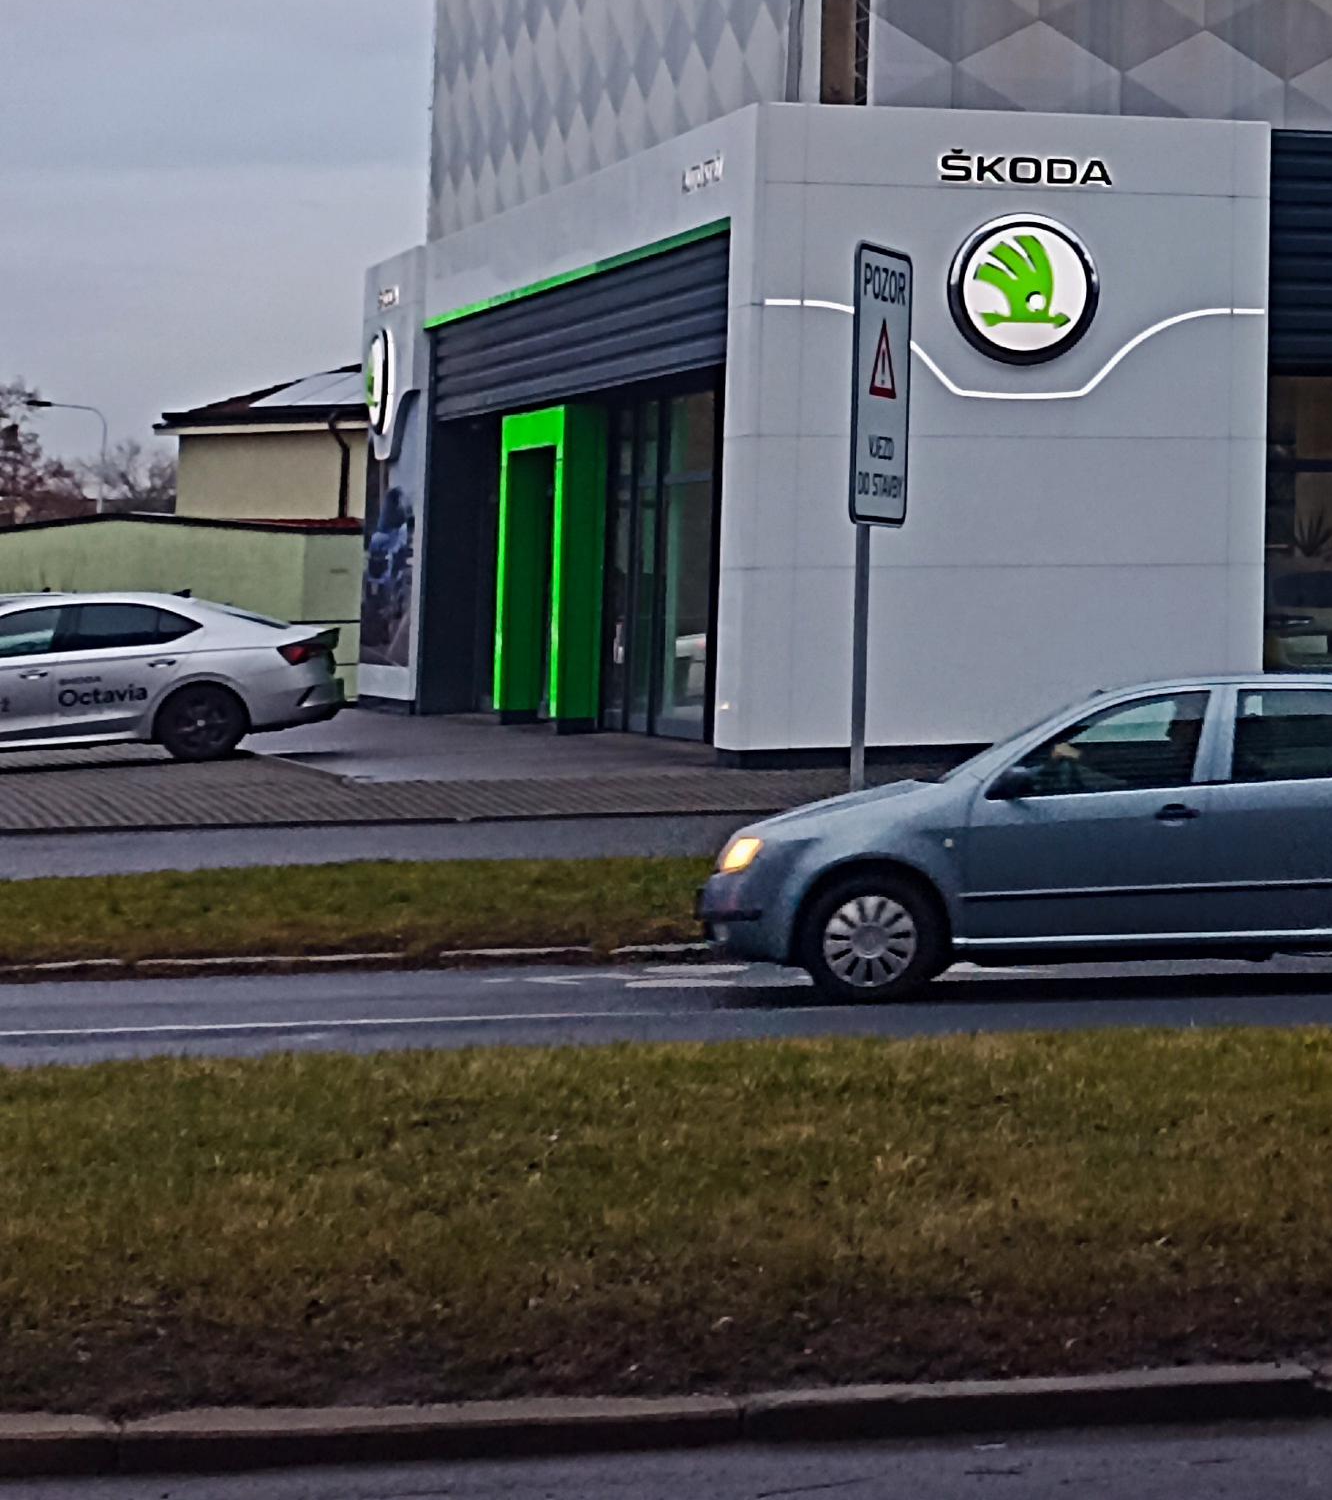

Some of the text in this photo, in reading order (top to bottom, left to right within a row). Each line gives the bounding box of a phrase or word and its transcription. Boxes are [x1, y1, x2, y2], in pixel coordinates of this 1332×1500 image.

[940, 148, 1112, 185] ŠKODA
[864, 262, 906, 306] POZOR
[58, 683, 148, 707] Octavia
